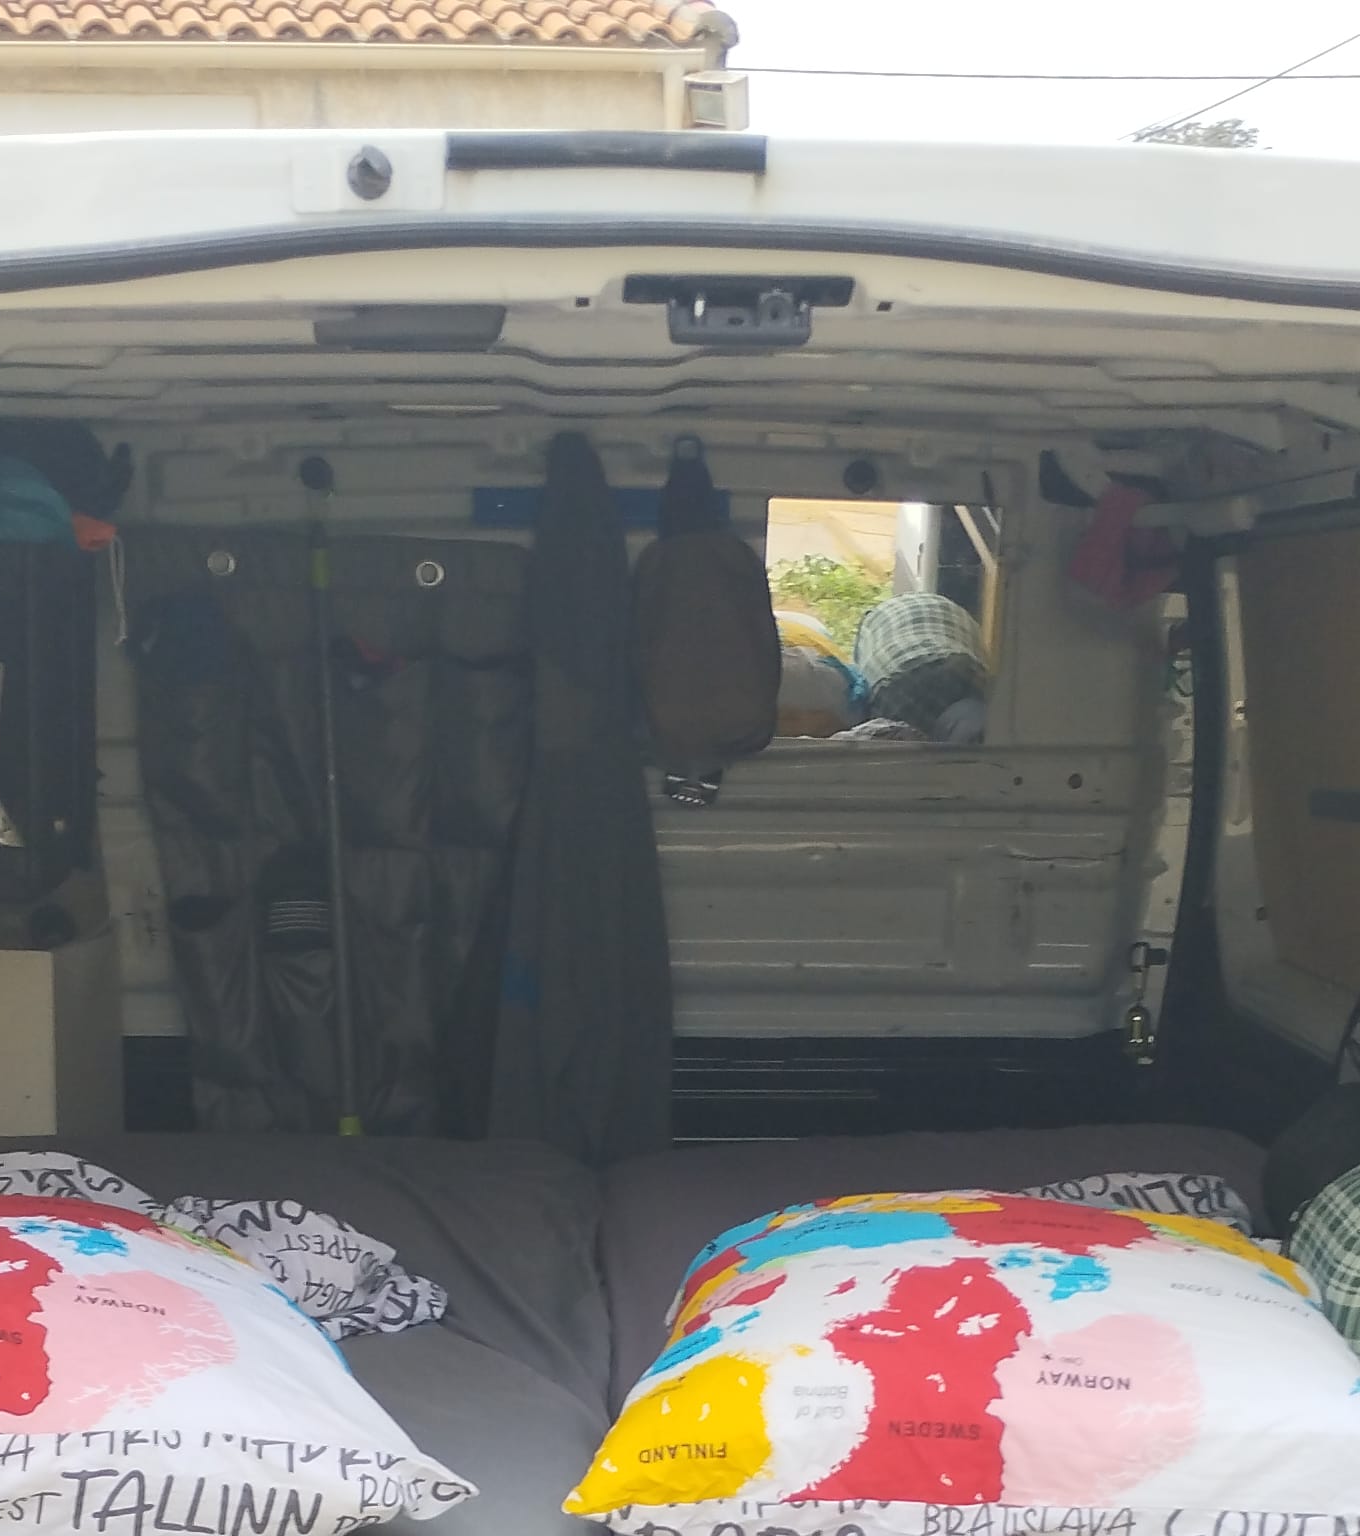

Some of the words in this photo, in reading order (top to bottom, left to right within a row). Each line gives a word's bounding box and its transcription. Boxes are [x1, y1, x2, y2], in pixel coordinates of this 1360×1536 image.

[73, 1294, 166, 1317] NORWAY
[1037, 1370, 1131, 1391] NORWAY
[888, 1419, 983, 1441] SWEDEN
[638, 1441, 729, 1465] FINLAND
